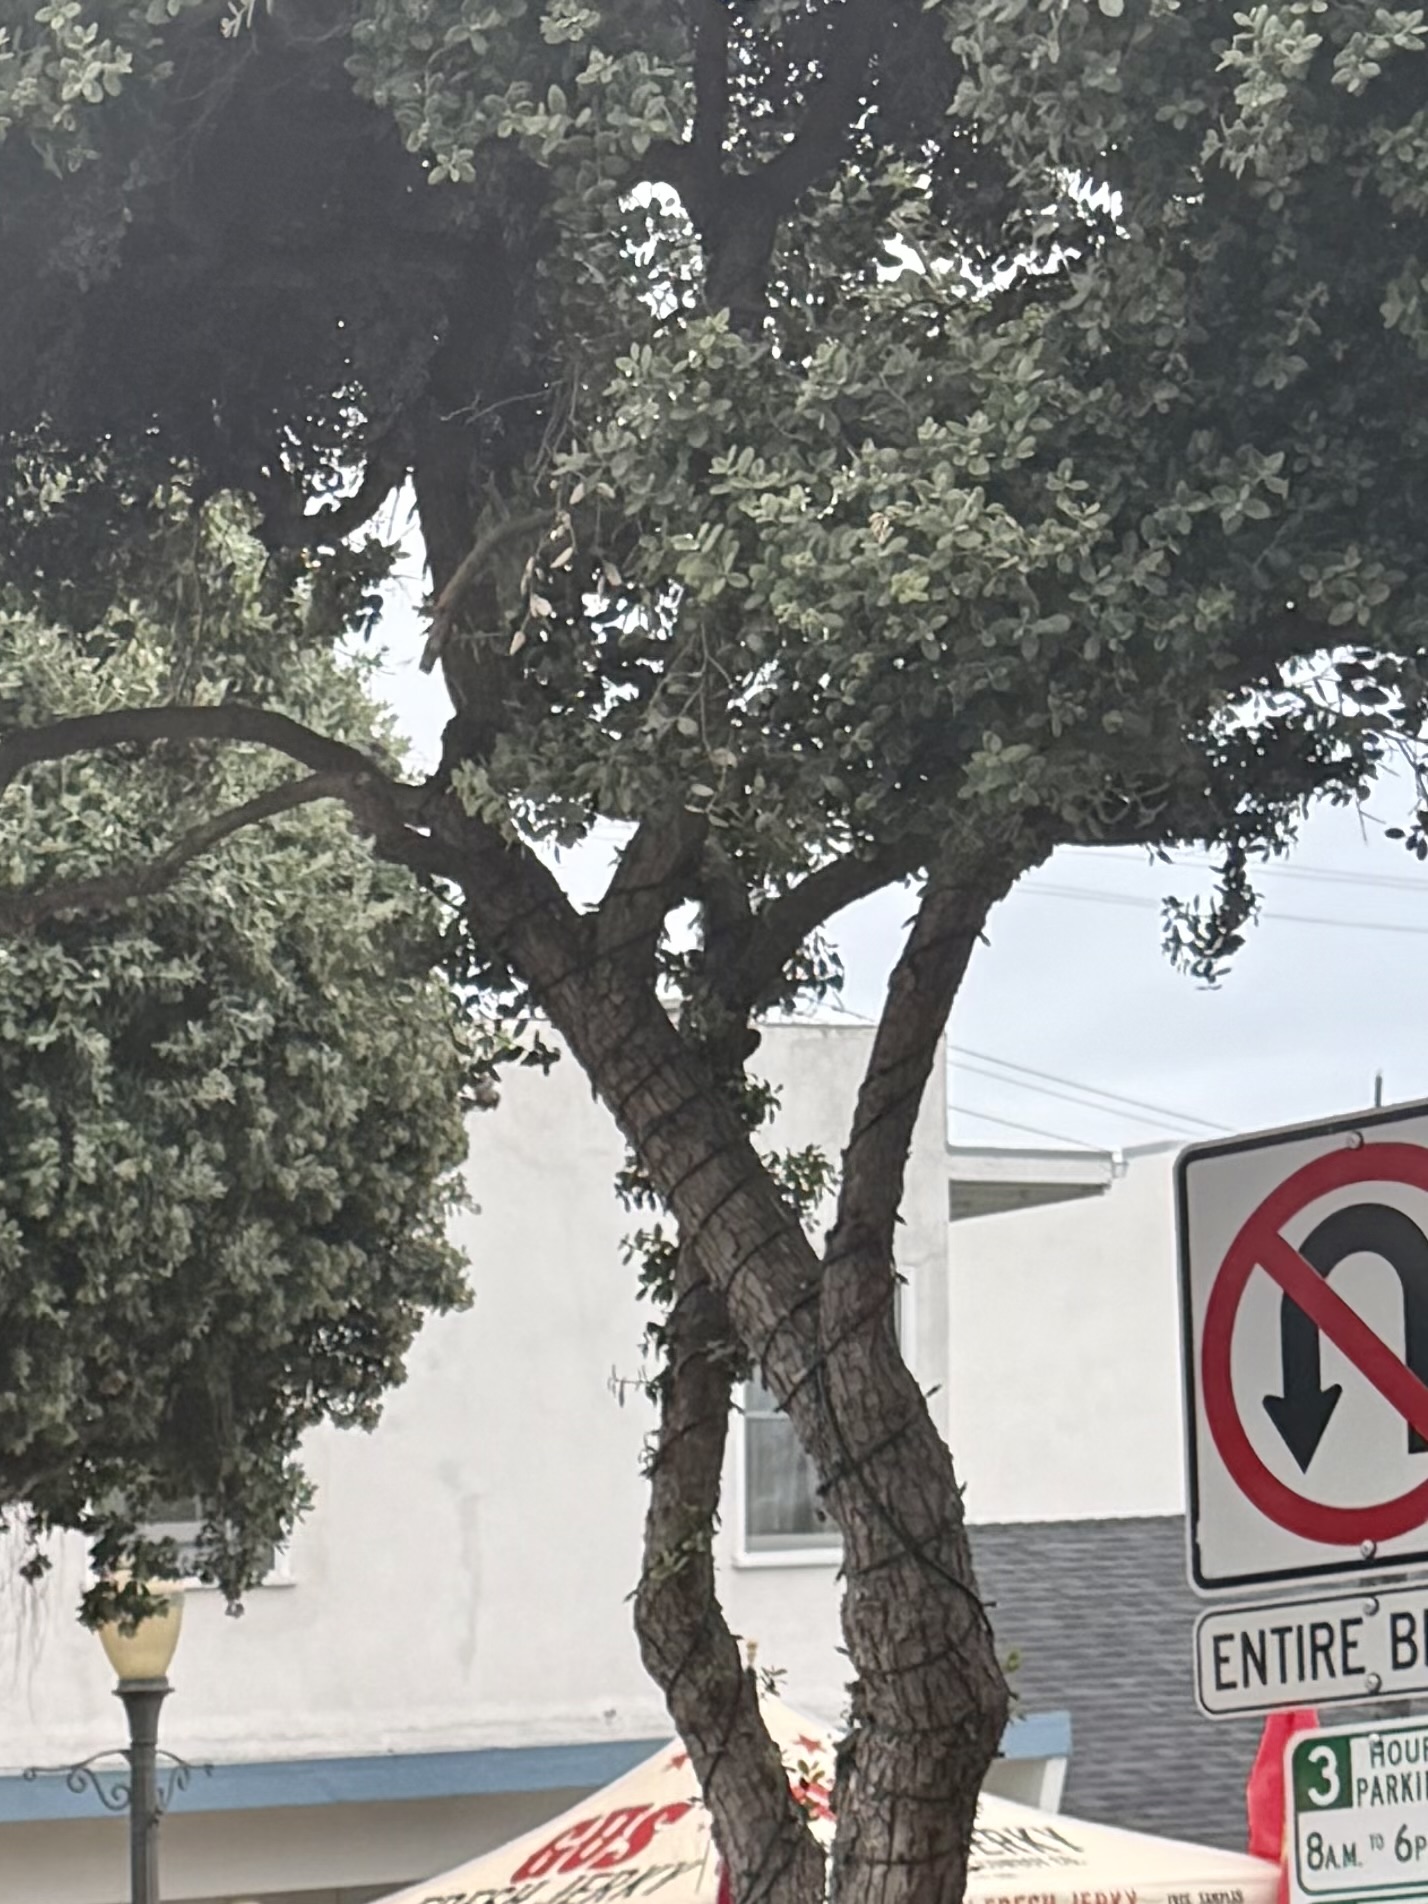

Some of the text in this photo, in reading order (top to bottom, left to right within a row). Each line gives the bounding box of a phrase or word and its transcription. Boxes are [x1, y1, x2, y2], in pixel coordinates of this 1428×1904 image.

[1212, 1608, 1428, 1692] ENTIRE B
[1307, 1744, 1341, 1808] 3
[1356, 1769, 1428, 1808] PARKI
[1369, 1832, 1385, 1851] TO
